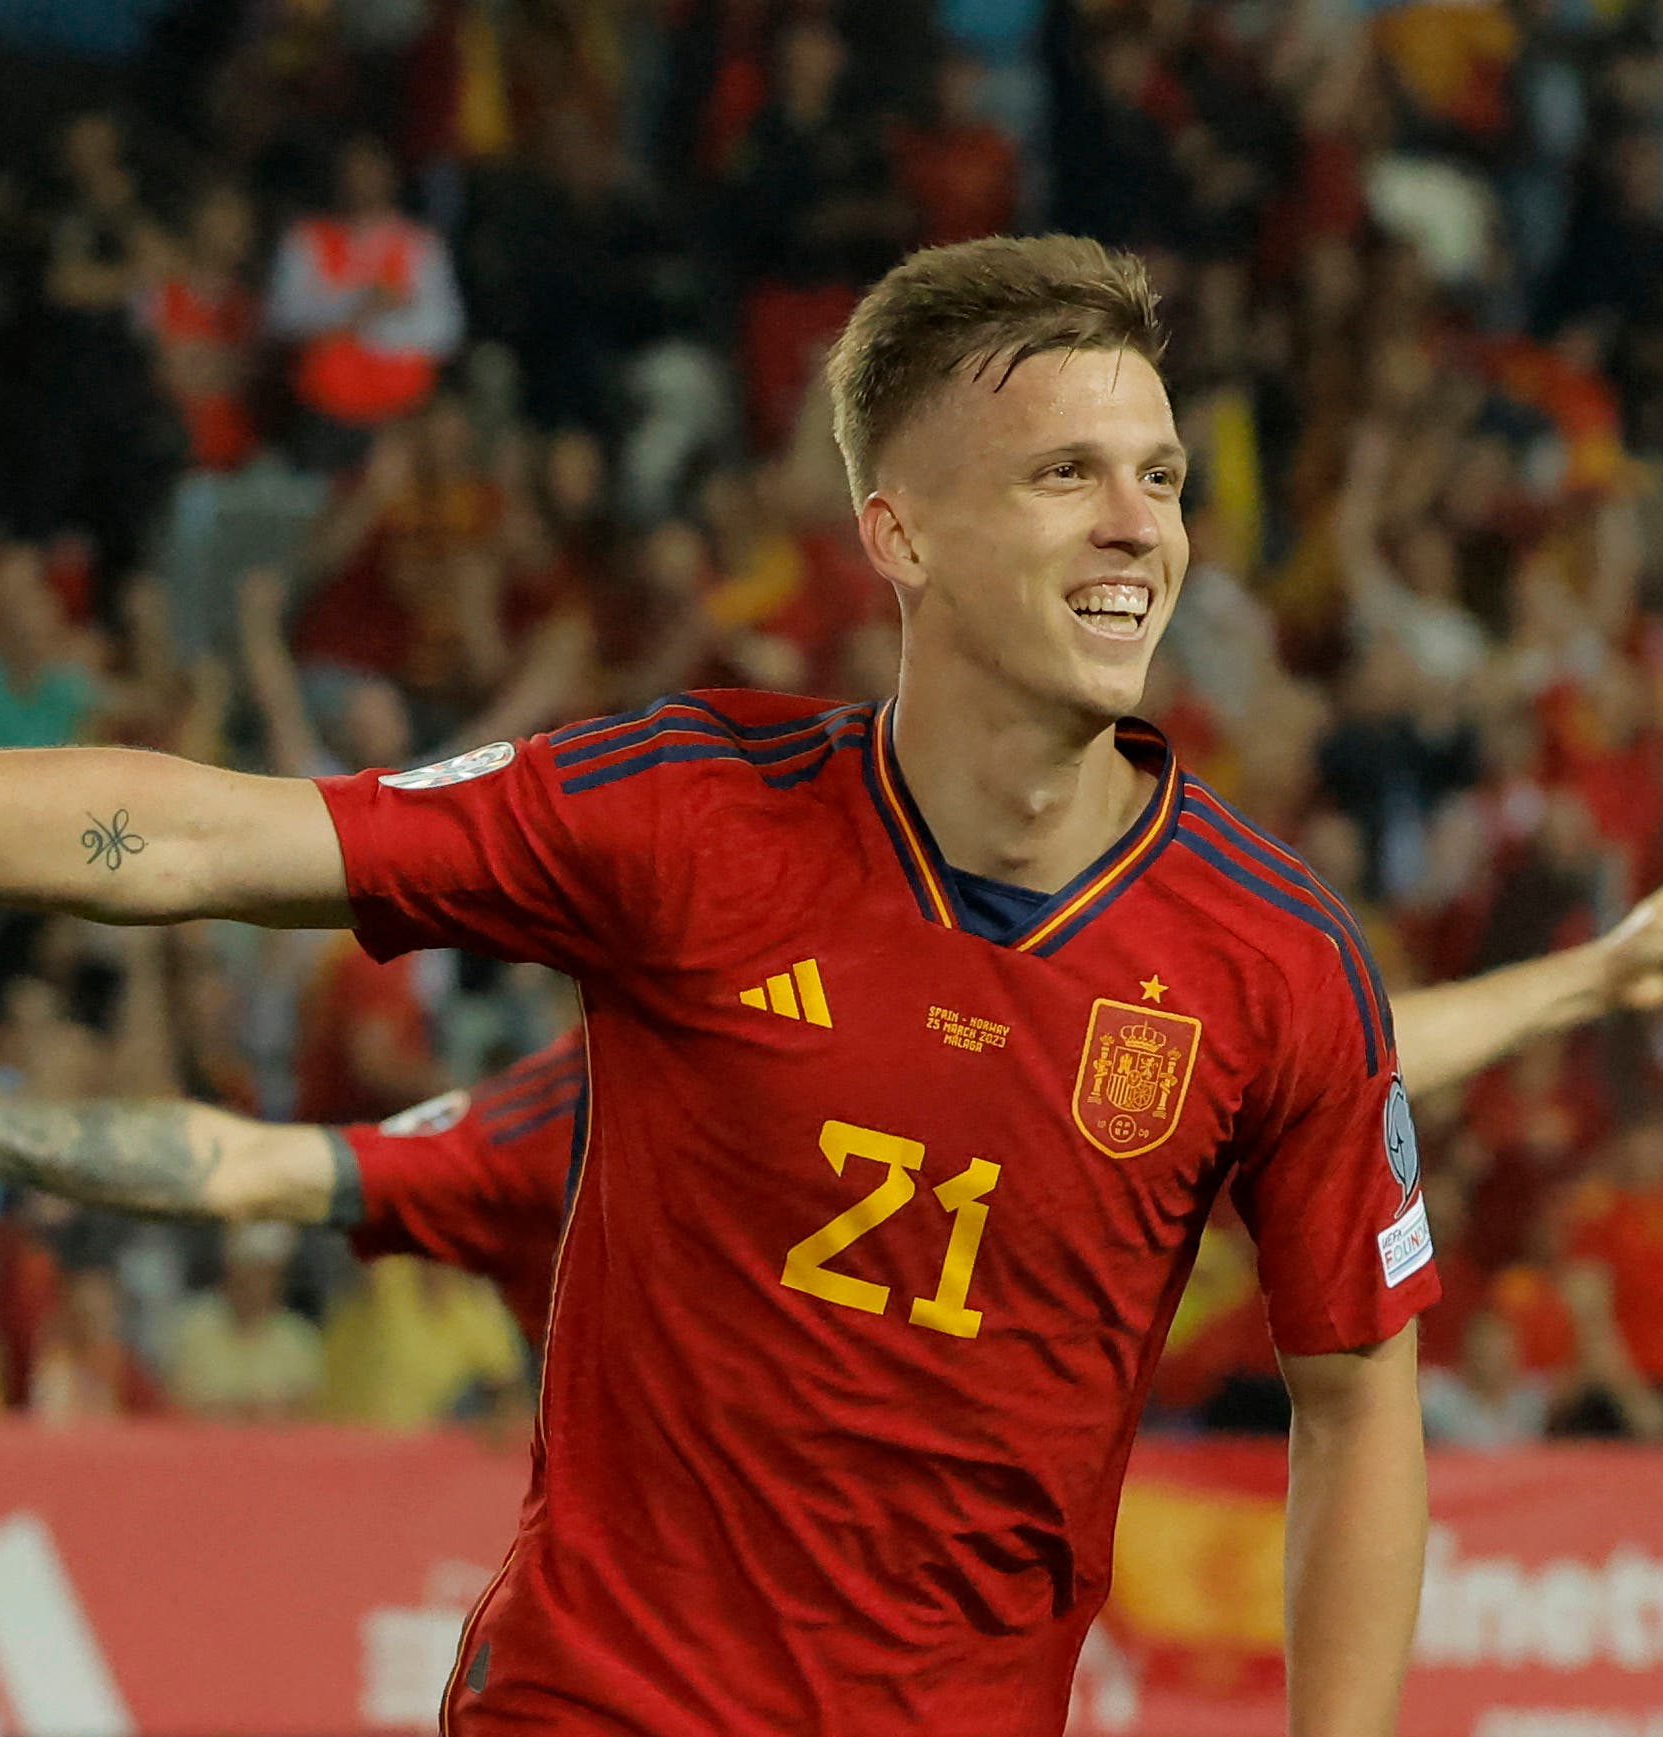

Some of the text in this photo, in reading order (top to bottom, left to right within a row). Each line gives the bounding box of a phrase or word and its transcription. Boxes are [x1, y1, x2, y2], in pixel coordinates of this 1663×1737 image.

[926, 1017, 1006, 1048] 25 MARCH 2023
[929, 1005, 959, 1023] SPAIN
[969, 1016, 1010, 1036] NORWAY
[780, 1120, 1002, 1339] 21
